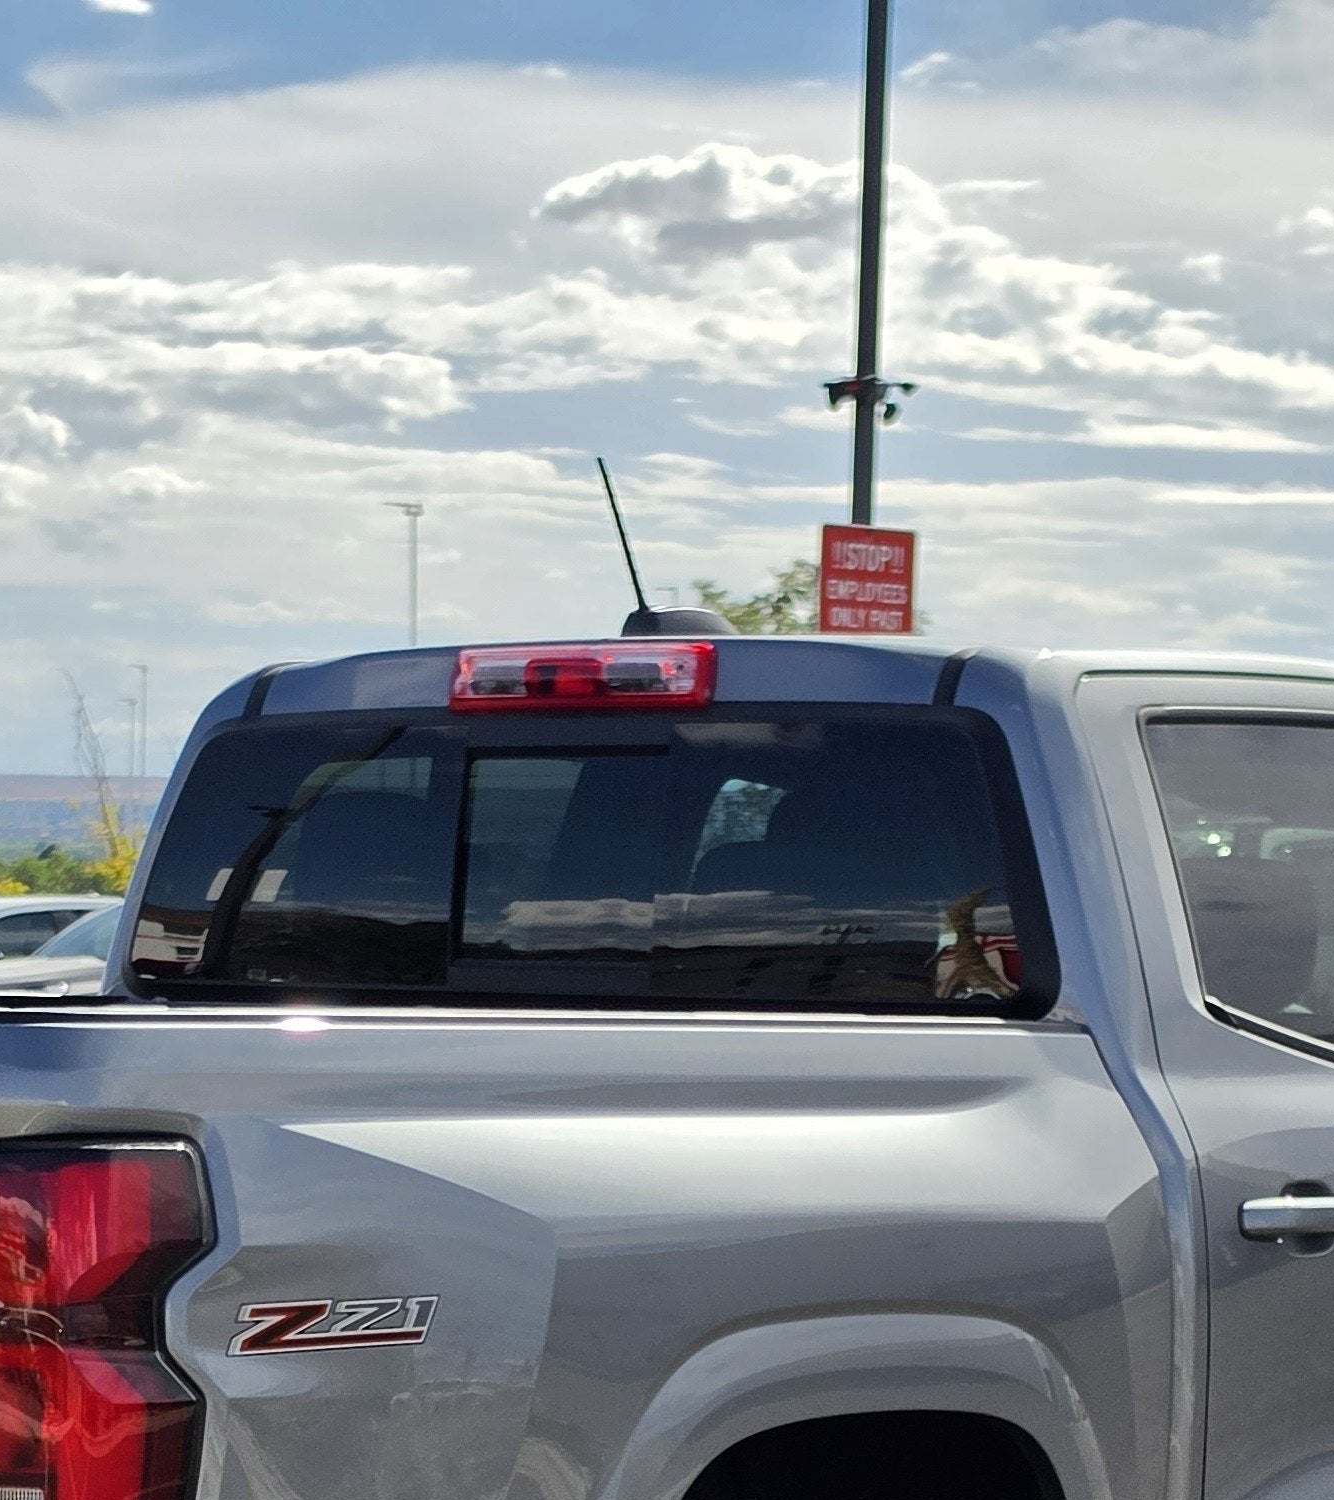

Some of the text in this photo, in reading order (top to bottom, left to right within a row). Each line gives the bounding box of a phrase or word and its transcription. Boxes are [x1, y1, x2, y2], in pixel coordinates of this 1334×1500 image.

[826, 579, 908, 604] EMPLOYEES
[829, 606, 866, 628] ONLY
[225, 1294, 440, 1357] Z71
